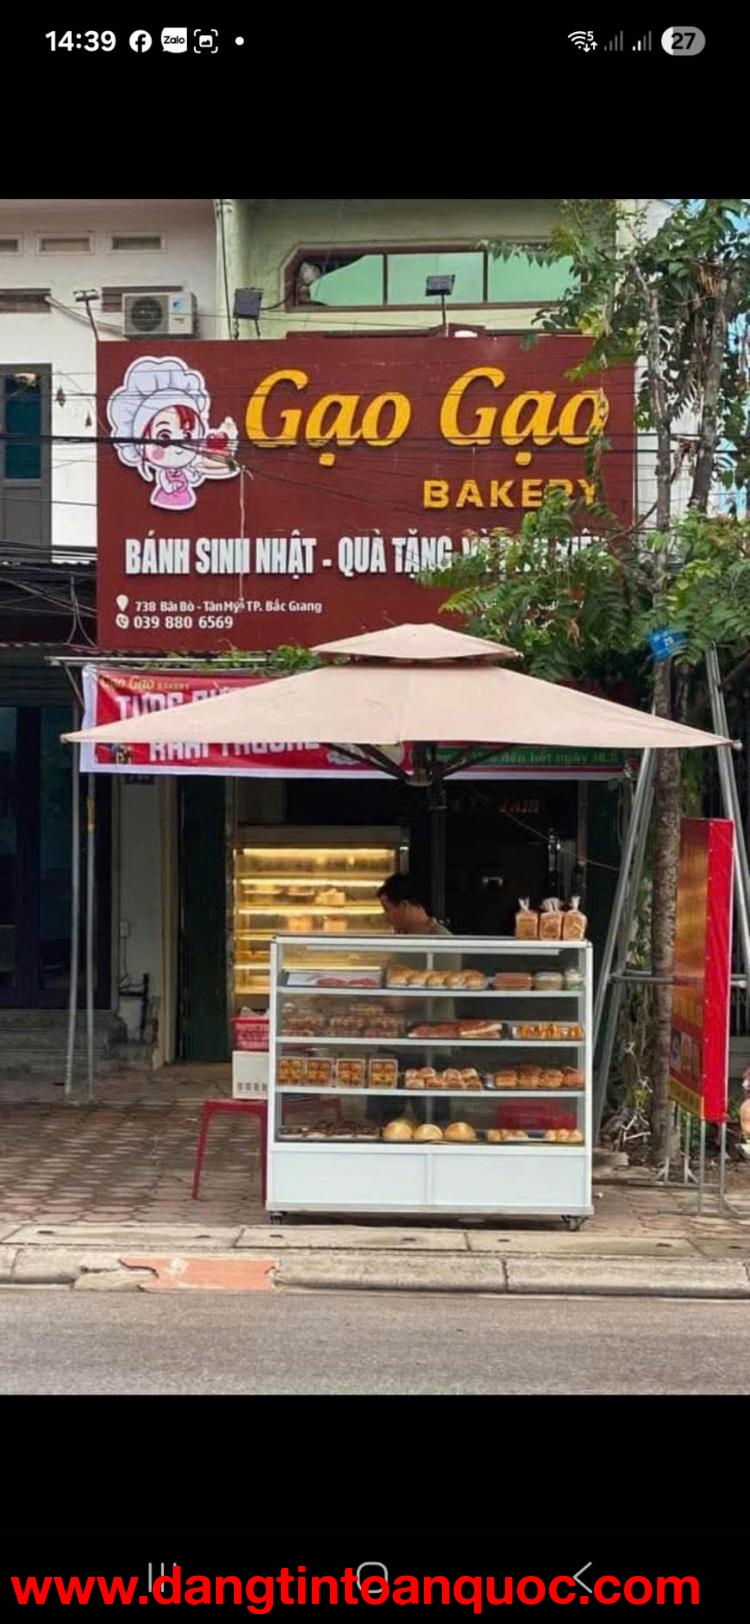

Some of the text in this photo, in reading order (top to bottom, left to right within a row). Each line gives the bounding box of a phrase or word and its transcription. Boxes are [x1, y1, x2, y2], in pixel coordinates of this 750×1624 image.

[245, 367, 609, 467] Gạo Gạo
[125, 530, 190, 574] BÁNH
[195, 536, 250, 574] SINH
[255, 529, 317, 579] NHẬT
[338, 528, 387, 577] QUÀ
[133, 616, 234, 629] 039 880 6569
[135, 601, 157, 613] 738
[246, 601, 263, 612] TP.
[288, 600, 322, 614] Giang
